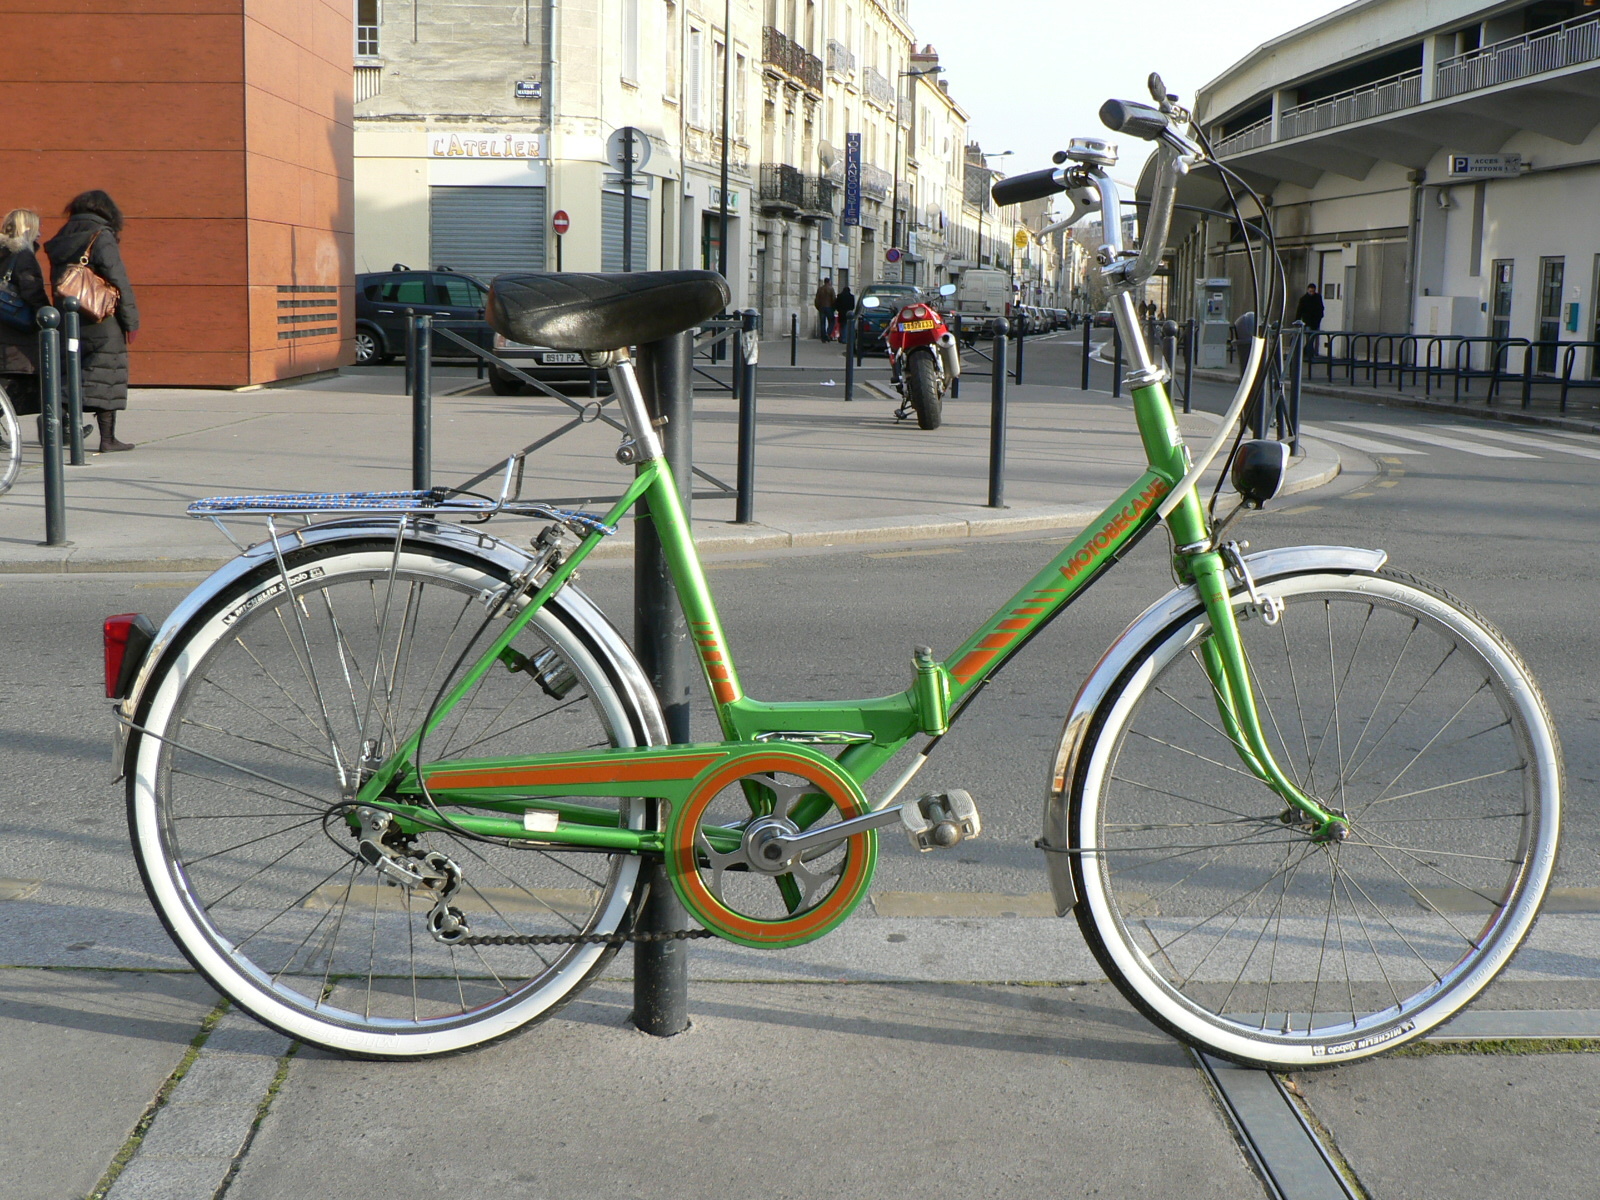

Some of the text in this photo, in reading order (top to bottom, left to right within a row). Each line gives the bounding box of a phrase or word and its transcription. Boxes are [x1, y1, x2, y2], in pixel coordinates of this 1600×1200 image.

[433, 133, 541, 157] L'ATELIER
[1059, 477, 1169, 581] MOTOBECANE
[234, 586, 278, 617] MICHELIN
[1327, 1027, 1403, 1054] MICHELIN diabolo
